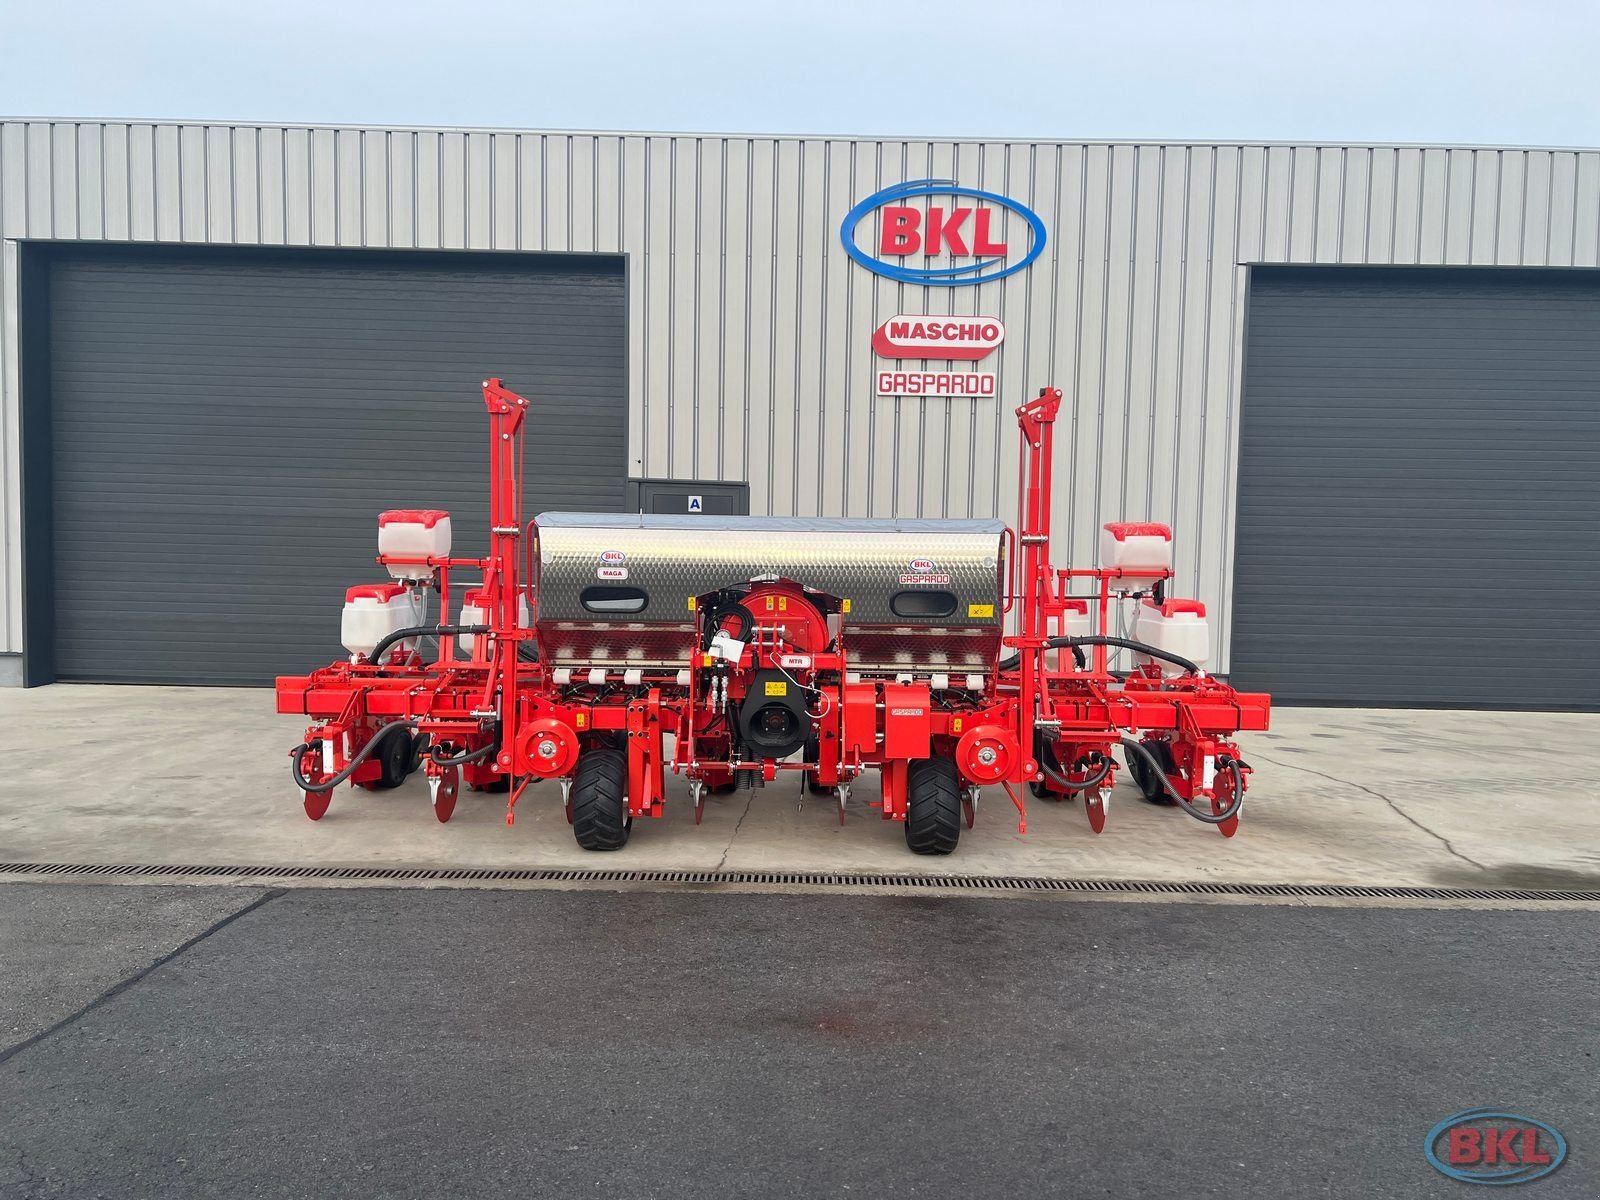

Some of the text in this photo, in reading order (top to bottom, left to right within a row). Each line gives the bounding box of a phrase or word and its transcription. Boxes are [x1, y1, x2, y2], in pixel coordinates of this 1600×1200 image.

[880, 206, 1008, 257] BKL
[890, 322, 999, 342] MASCHIO
[879, 373, 994, 394] GASPARDO
[690, 498, 701, 509] A
[605, 552, 622, 560] BKL
[900, 575, 949, 583] GASPARDO
